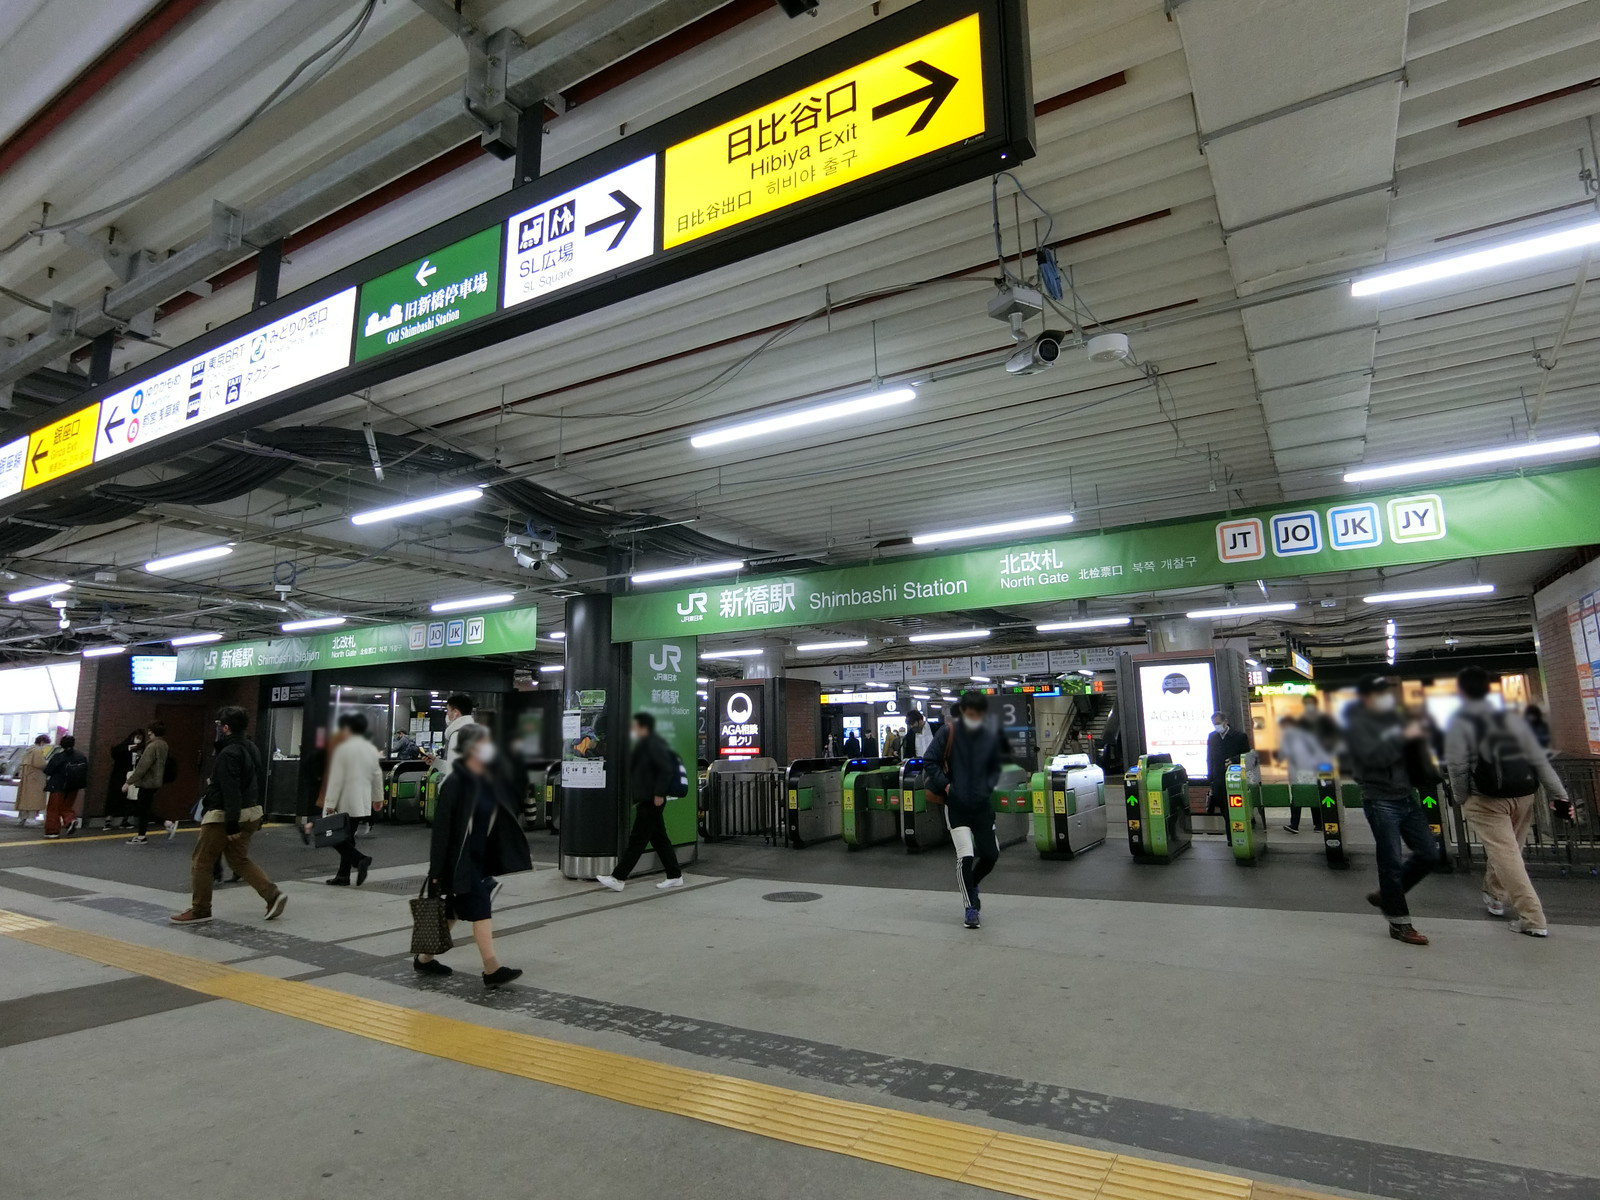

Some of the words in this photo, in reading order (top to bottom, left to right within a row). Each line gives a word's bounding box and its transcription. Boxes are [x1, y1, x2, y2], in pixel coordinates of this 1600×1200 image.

[727, 80, 858, 165] 日比谷口
[751, 144, 811, 180] Hibiya
[819, 122, 858, 153] Exit
[766, 164, 816, 195] 히비야
[824, 149, 858, 177] 출구
[677, 190, 752, 233] 日比谷出口
[519, 241, 574, 278] SL広場
[523, 280, 535, 293] SL
[538, 267, 574, 288] Square
[404, 271, 488, 321] 旧新橋停車場
[269, 306, 328, 343] みどりの窓口
[386, 328, 400, 344] Old
[400, 315, 435, 340] Shimbashi
[435, 309, 460, 327] Station
[208, 343, 245, 368] 東京BRT
[245, 364, 281, 386] タクシー
[1229, 532, 1251, 550] JT
[1281, 525, 1311, 544] JO
[1340, 517, 1368, 537] JK
[1402, 508, 1430, 530] JY
[999, 547, 1064, 576] 北改札
[999, 573, 1035, 590] North
[1038, 570, 1070, 587] Gate
[677, 592, 708, 616] JR
[719, 582, 796, 618] 新橋駅
[809, 583, 898, 610] Shimbashi
[903, 578, 968, 600] Station
[332, 635, 357, 650] 北改札
[431, 629, 442, 640] JO
[450, 627, 460, 639] JK
[470, 625, 481, 637] JY
[204, 650, 218, 665] JR
[220, 647, 253, 669] 新橋駅
[257, 653, 293, 666] Shimbashi
[294, 650, 320, 662] Station
[331, 650, 345, 659] North
[345, 649, 357, 658] Gate
[649, 644, 682, 673] JR
[653, 672, 678, 682] JR東日本
[1254, 682, 1316, 696] NewDays
[651, 688, 680, 705] 新橋駅
[698, 716, 705, 734] 2
[1003, 703, 1016, 725] 3
[1227, 772, 1241, 782] IC
[1230, 796, 1242, 807] IC
